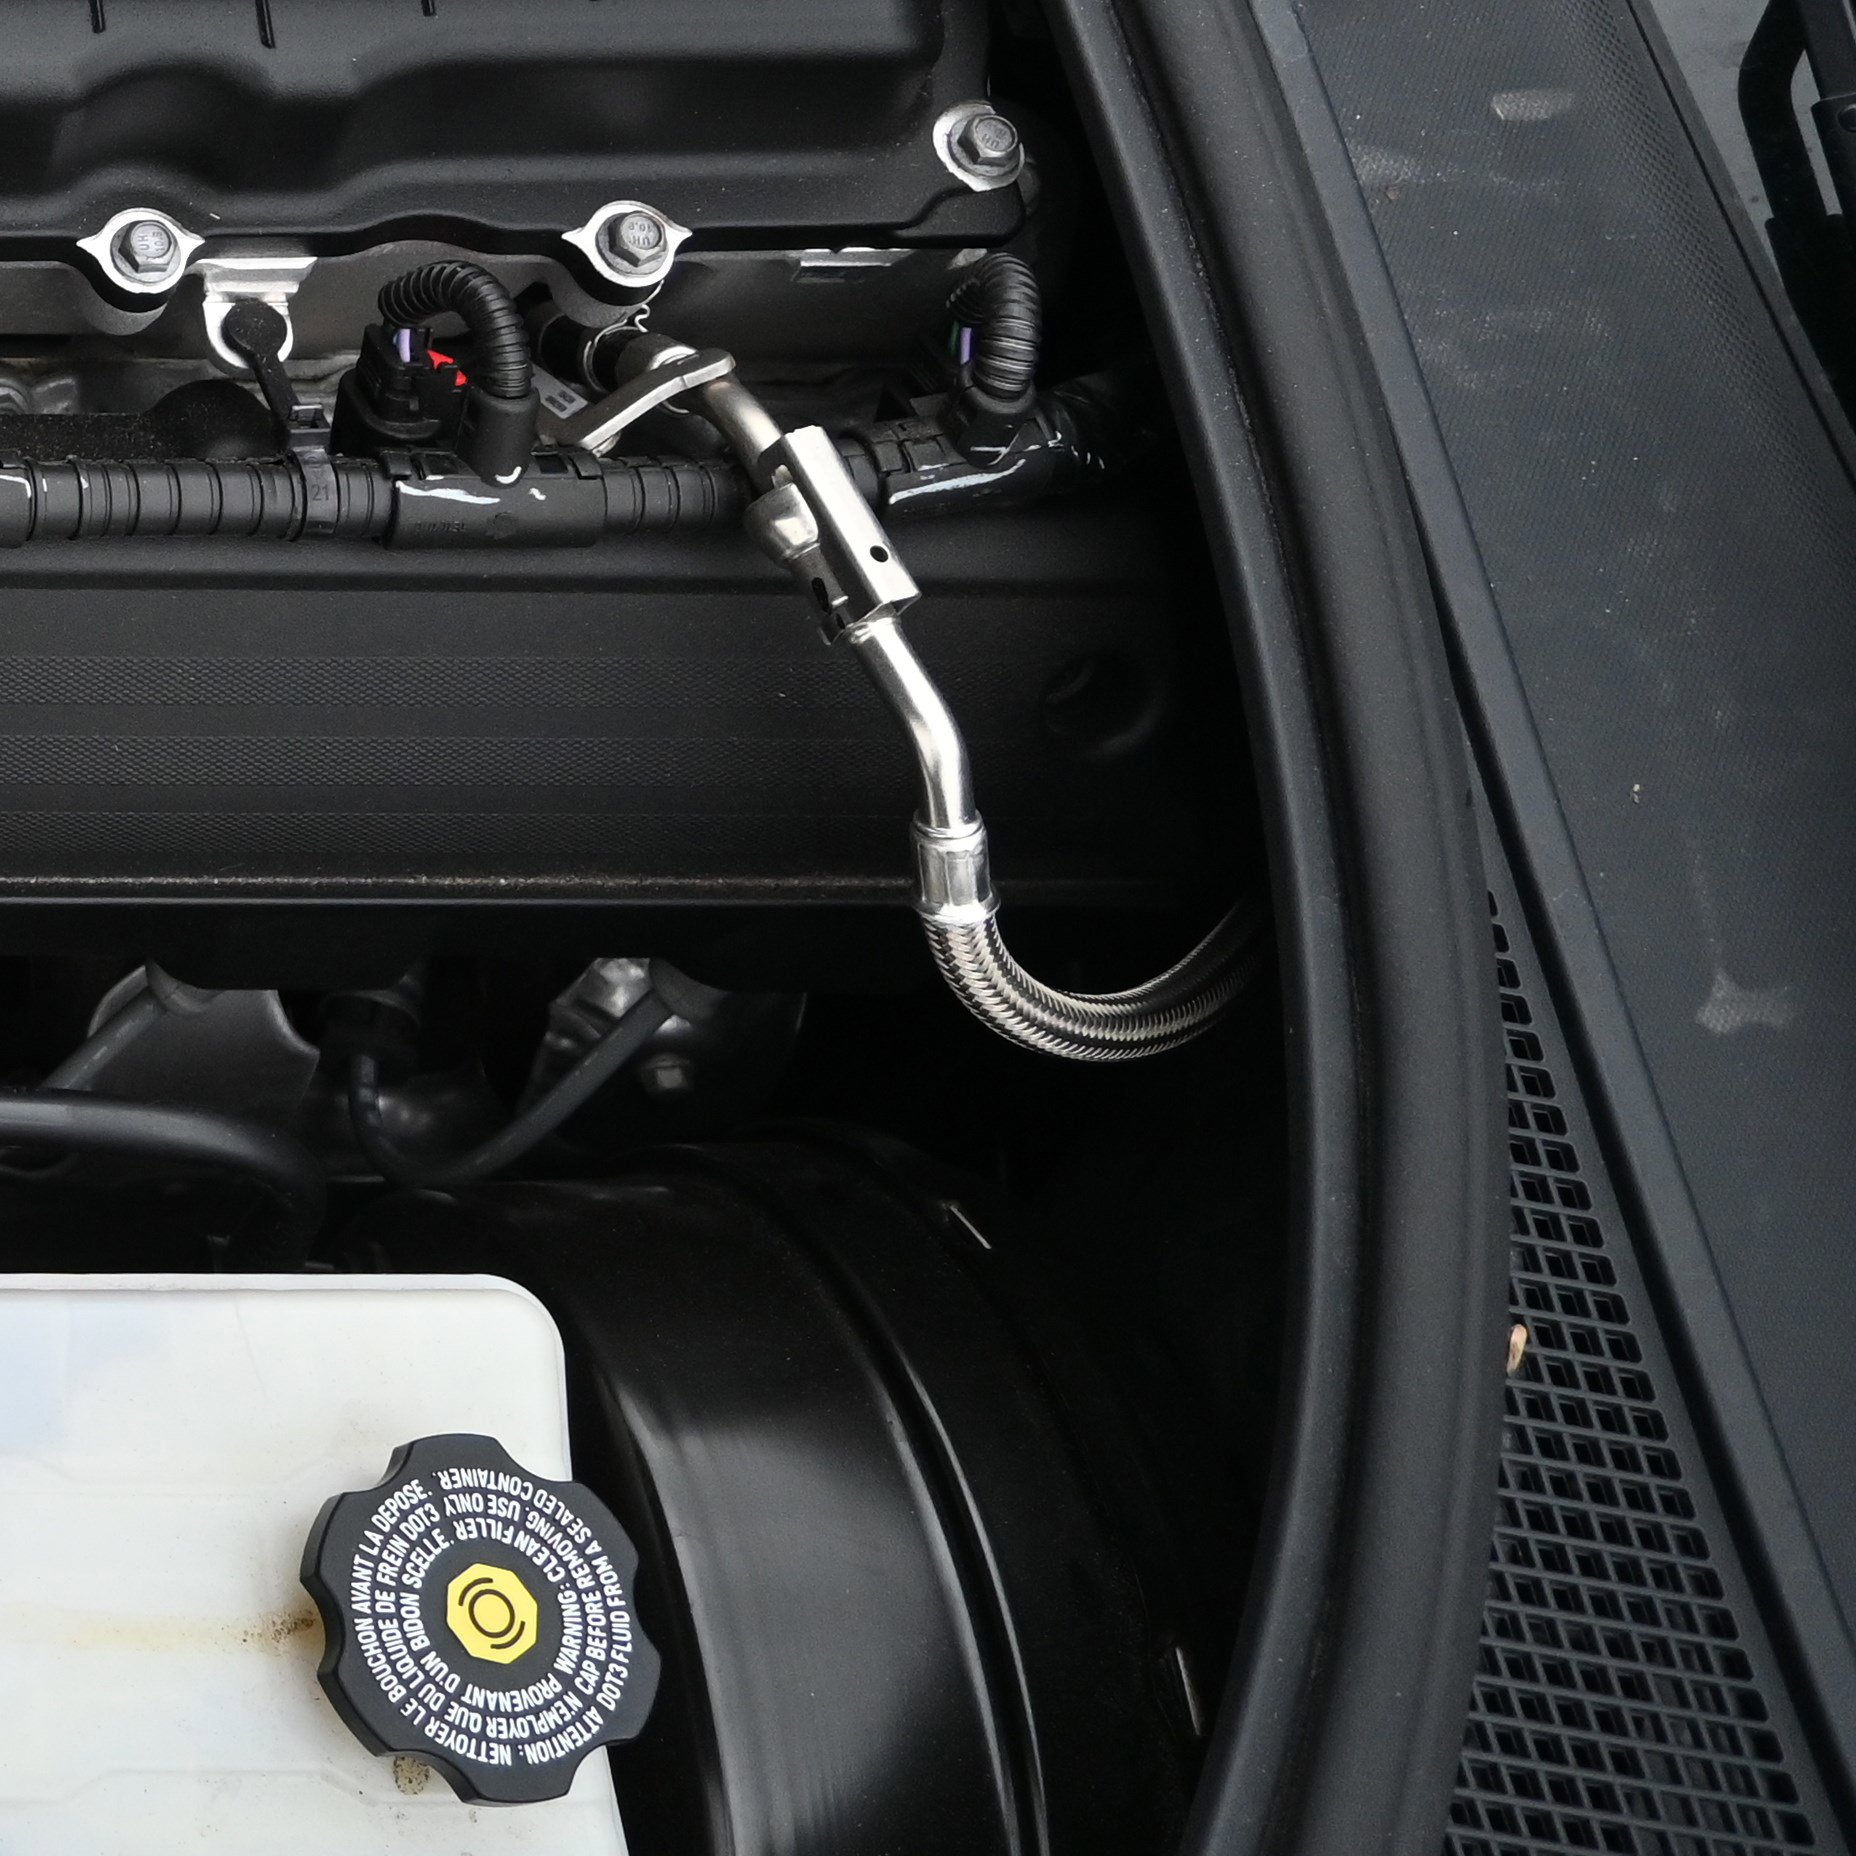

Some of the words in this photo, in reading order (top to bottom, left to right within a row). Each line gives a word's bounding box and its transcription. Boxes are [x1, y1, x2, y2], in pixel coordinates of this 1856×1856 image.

[310, 483, 329, 501] 21
[370, 1478, 433, 1533] DEPOSE.
[432, 1467, 534, 1502] CONTAINER.
[443, 1492, 485, 1518] ONLY
[486, 1493, 521, 1523] USE
[398, 1502, 441, 1542] DOT3
[452, 1516, 515, 1545] FILLER
[532, 1488, 592, 1544] SEALED
[358, 1529, 385, 1557] LA
[375, 1533, 411, 1587] FREIN
[401, 1527, 455, 1590] SCELLE.
[513, 1529, 566, 1583] CLEAN
[524, 1506, 596, 1590] REMOVING.
[584, 1539, 603, 1556] A
[350, 1553, 375, 1615] AVANT
[374, 1589, 397, 1614] DE
[590, 1555, 627, 1608] FROM
[399, 1591, 431, 1652] BIDON
[553, 1582, 584, 1675] WARNING:
[580, 1589, 608, 1662] BEFORE
[609, 1610, 633, 1664] FLUID
[353, 1617, 408, 1704] BOUCHON
[377, 1617, 426, 1690] LIQUIDE
[419, 1650, 461, 1694] D'UN
[573, 1659, 601, 1696] CAP
[400, 1697, 427, 1726] LE
[417, 1682, 446, 1712] DU
[460, 1672, 563, 1713] PROVENANT
[595, 1662, 629, 1712] DOT3
[443, 1700, 483, 1734] QUE
[485, 1690, 584, 1740] N'EMPLOYER
[517, 1705, 604, 1765] ATTENTION:
[424, 1715, 513, 1767] NETTOYER
